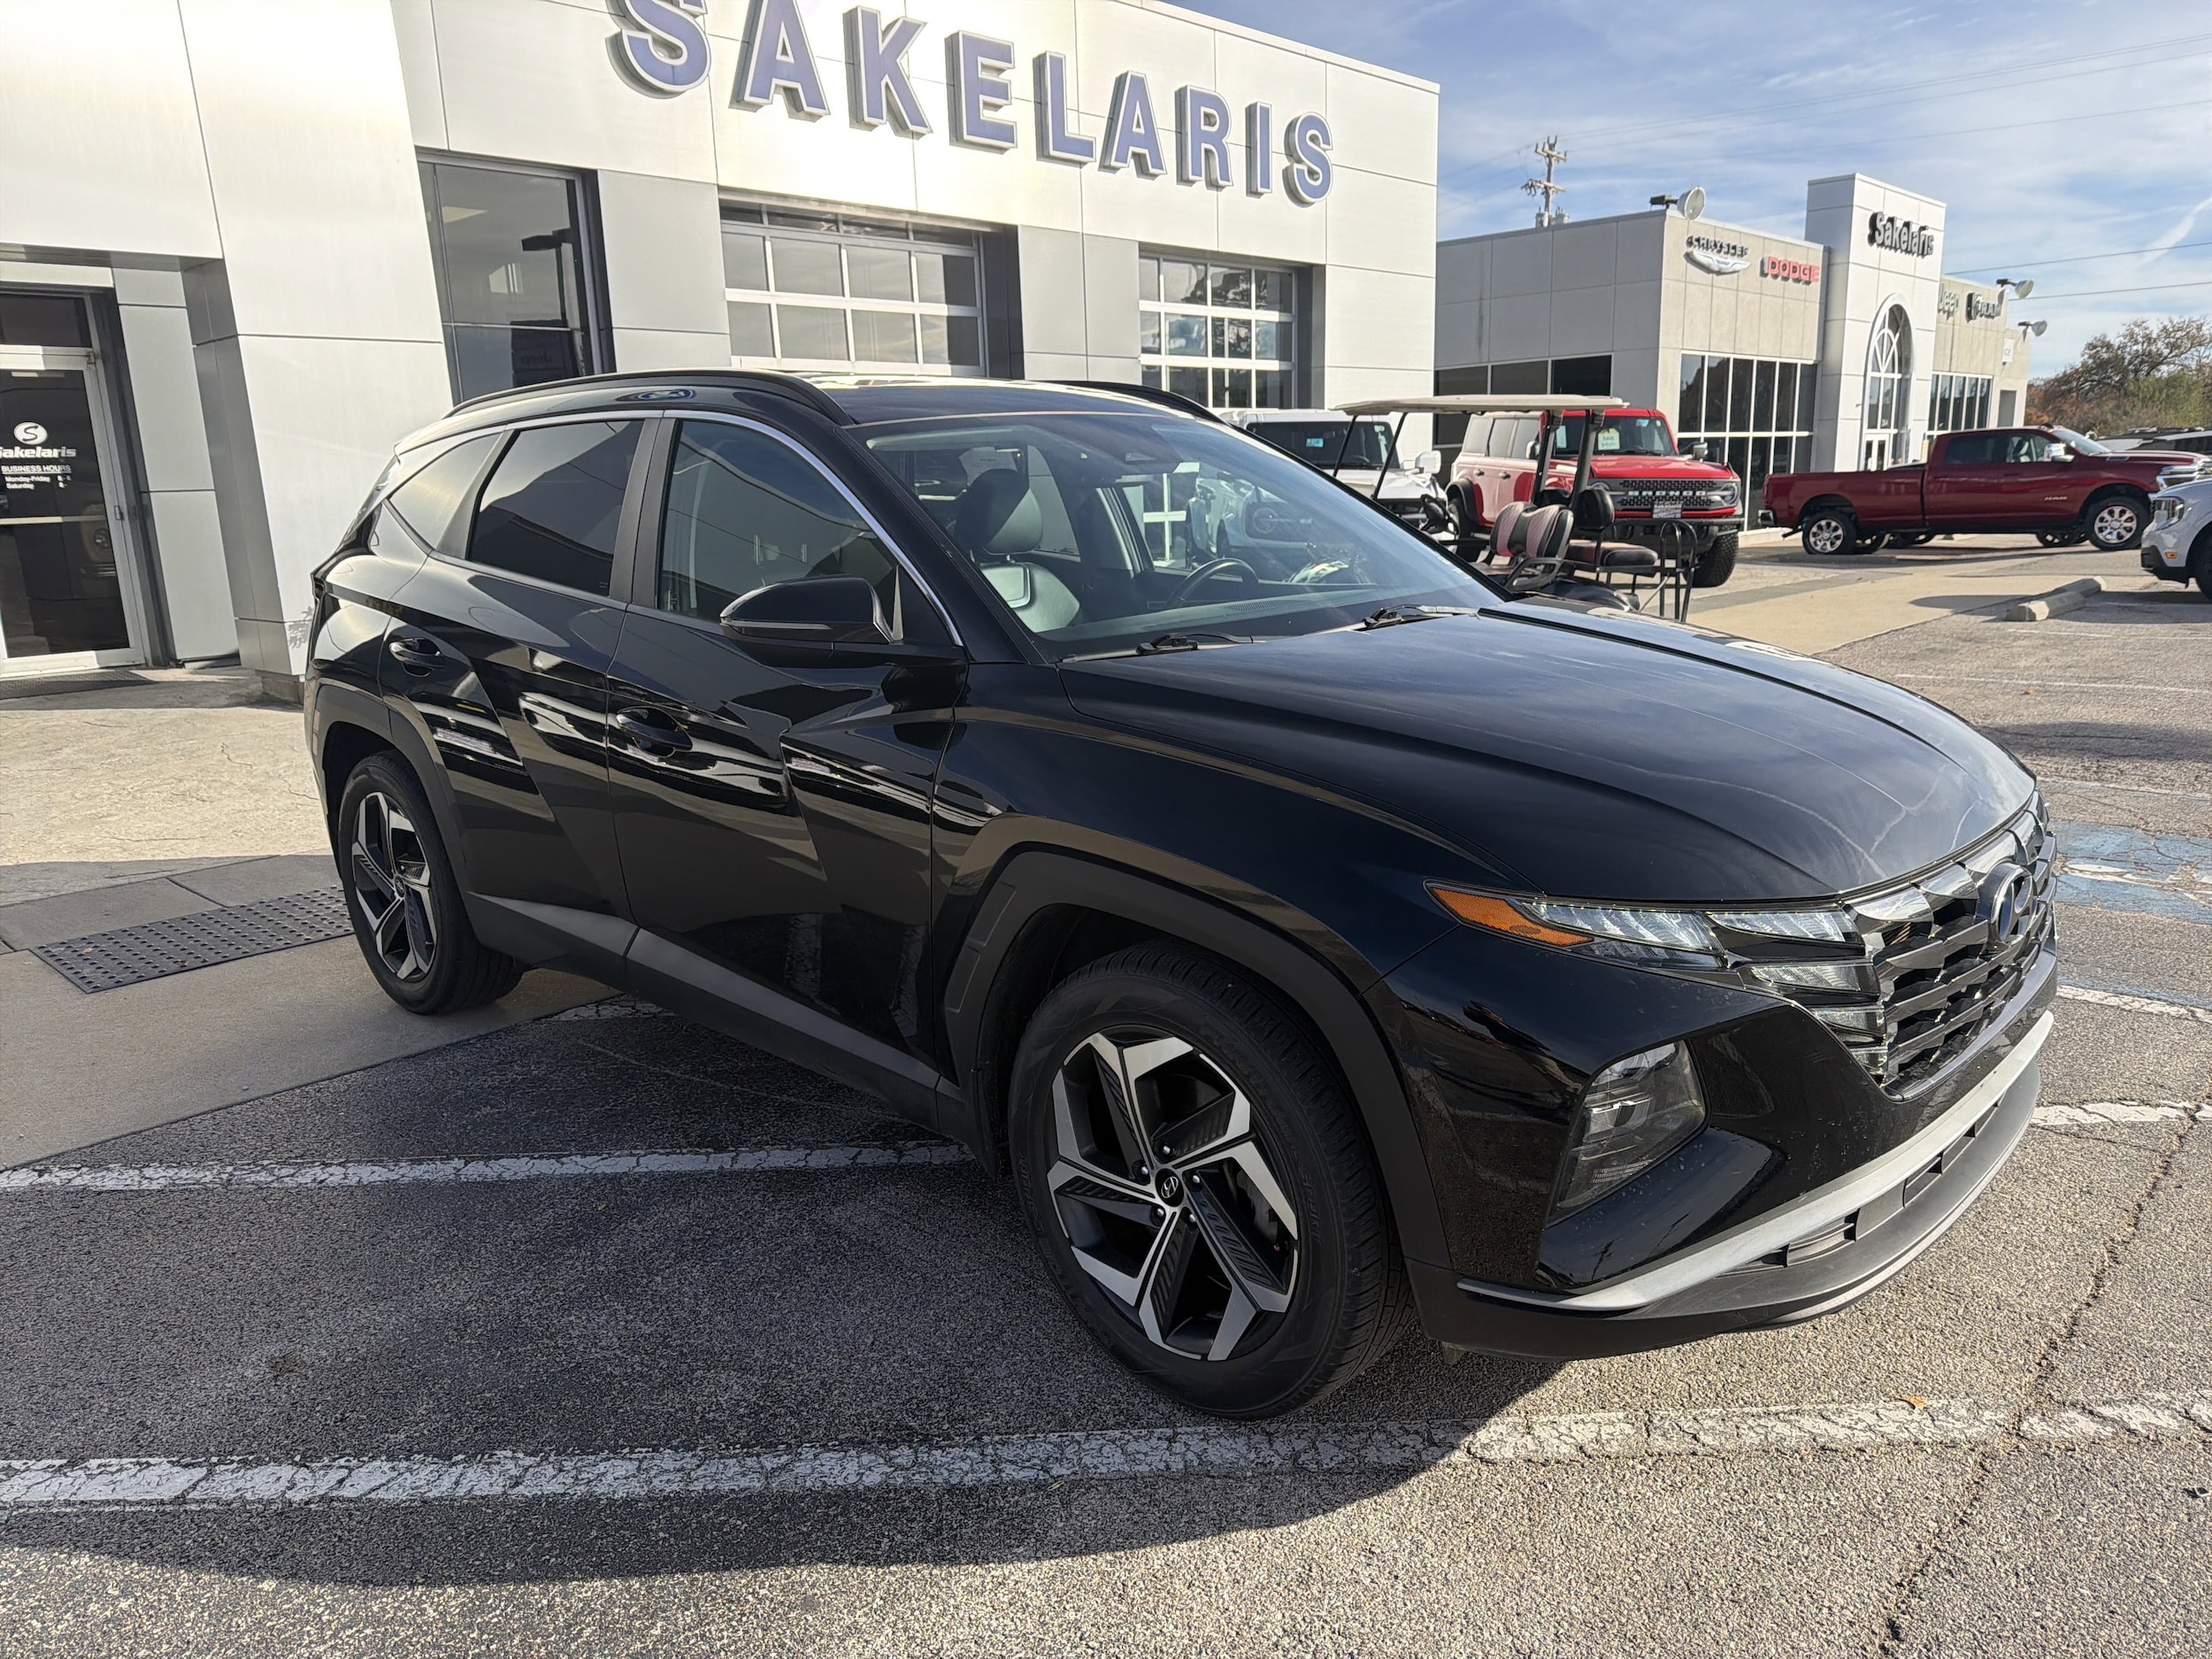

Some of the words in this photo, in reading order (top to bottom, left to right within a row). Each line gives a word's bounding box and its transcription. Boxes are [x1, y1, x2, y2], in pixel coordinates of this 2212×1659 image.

[605, 0, 1333, 204] SAKELARIS
[1869, 212, 1934, 258] Sakelaris
[1762, 256, 1820, 284] DODGE
